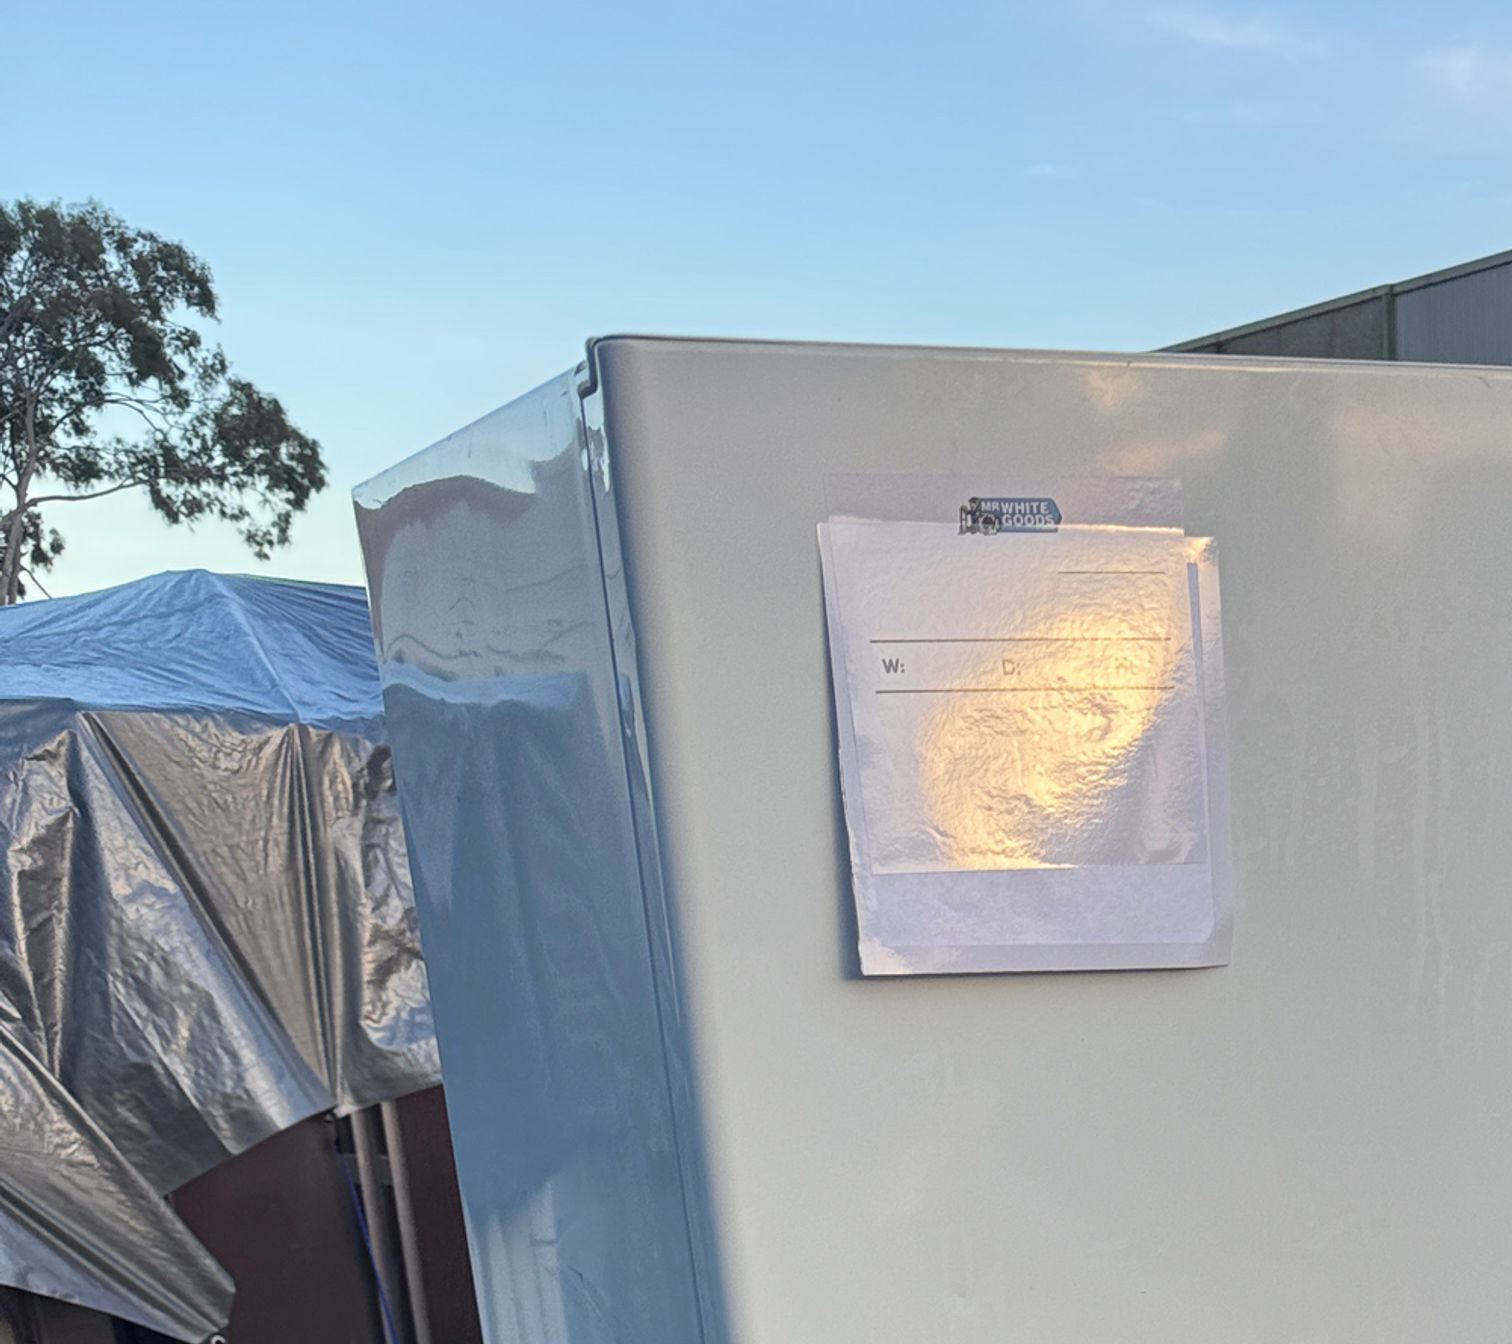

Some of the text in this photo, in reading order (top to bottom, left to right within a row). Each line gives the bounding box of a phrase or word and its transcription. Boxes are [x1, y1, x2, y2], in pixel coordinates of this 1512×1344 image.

[1001, 501, 1049, 514] WHITE
[1002, 513, 1056, 527] GOODS
[881, 657, 906, 674] W:
